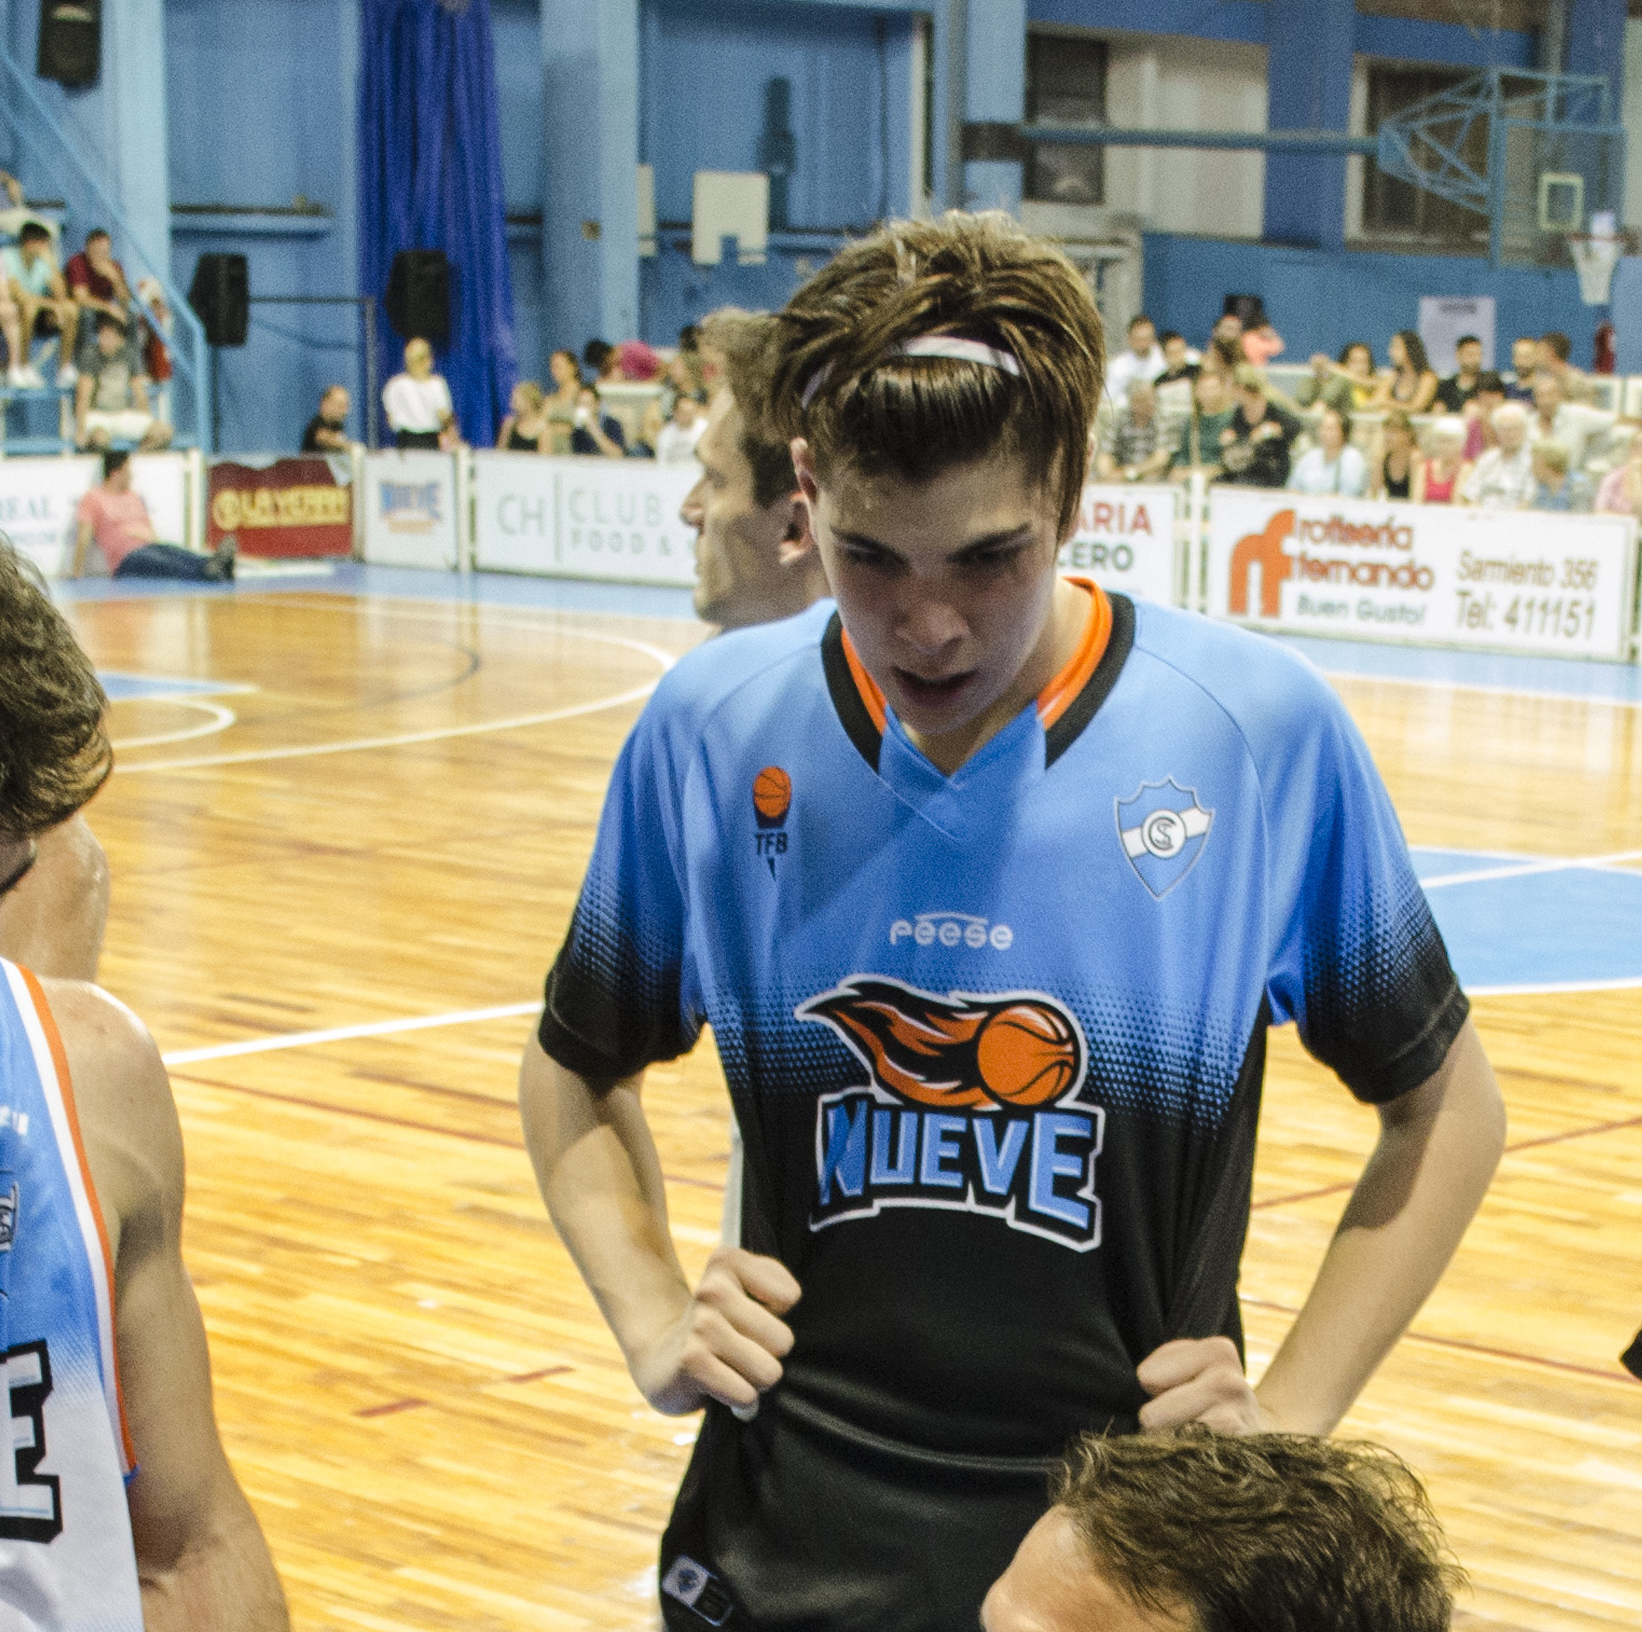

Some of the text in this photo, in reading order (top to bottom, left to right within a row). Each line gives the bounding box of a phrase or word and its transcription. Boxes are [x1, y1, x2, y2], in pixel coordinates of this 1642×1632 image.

[495, 486, 663, 540] CH CLUB
[570, 530, 644, 555] FOOD
[1299, 552, 1435, 592] fernando
[1456, 548, 1598, 591] Sarmiento 356
[1455, 590, 1596, 640] Tel: 411151
[754, 831, 788, 856] TFB
[811, 1090, 1105, 1252] NUEVE
